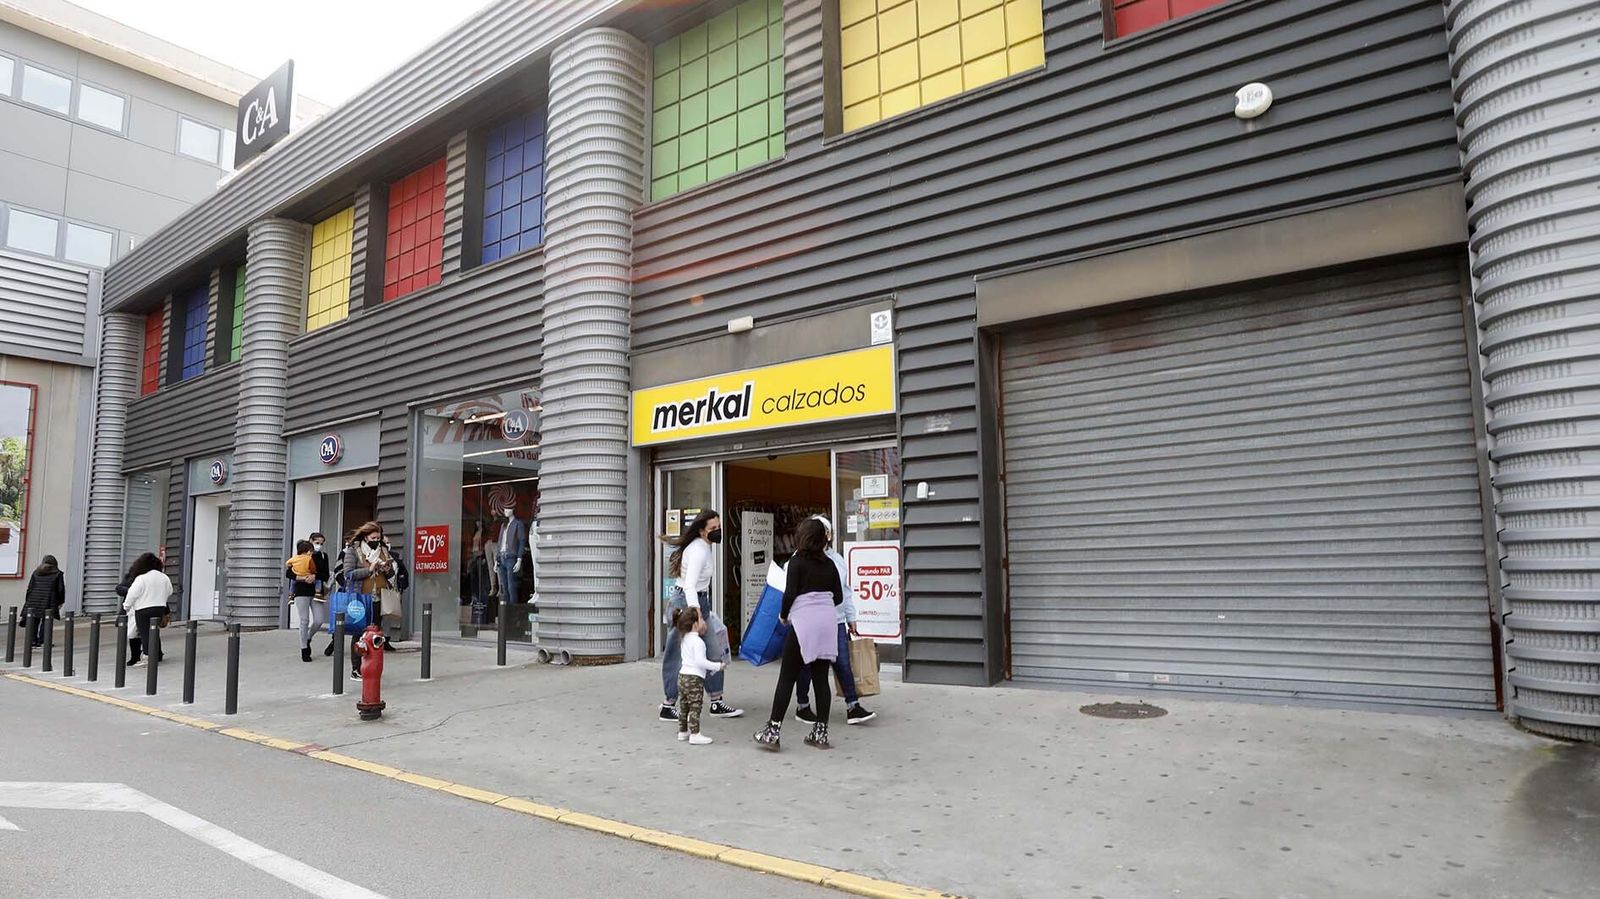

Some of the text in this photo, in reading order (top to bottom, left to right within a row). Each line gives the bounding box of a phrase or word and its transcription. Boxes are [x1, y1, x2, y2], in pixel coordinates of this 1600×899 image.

[242, 86, 279, 145] C&A
[653, 383, 866, 430] merkal calzados
[505, 415, 525, 434] C&A
[415, 560, 448, 570] ÚLTIMOS DÍAS
[858, 567, 879, 575] Segundo
[854, 580, 896, 601] -50%
